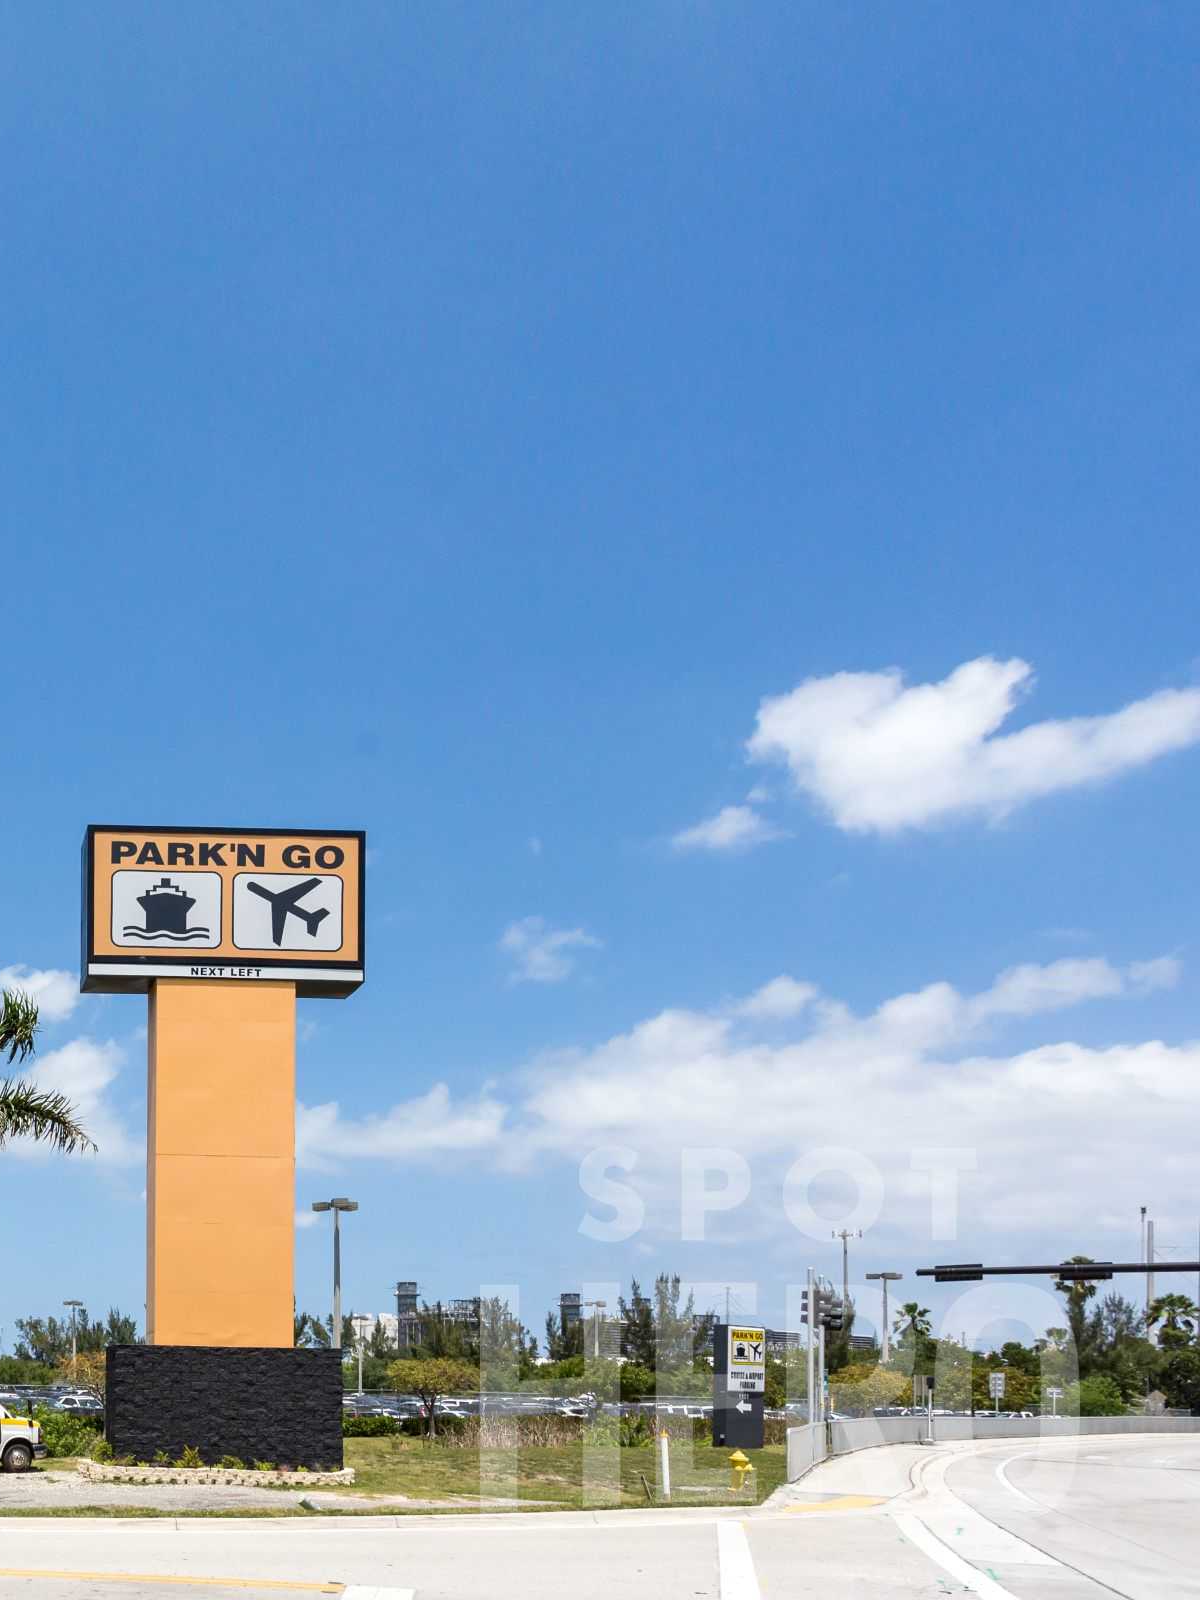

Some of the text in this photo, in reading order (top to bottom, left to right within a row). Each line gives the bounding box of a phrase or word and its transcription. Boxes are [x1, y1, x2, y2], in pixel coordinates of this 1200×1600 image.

[111, 840, 345, 870] PARK'N GO
[190, 966, 262, 978] NEXT LEFT
